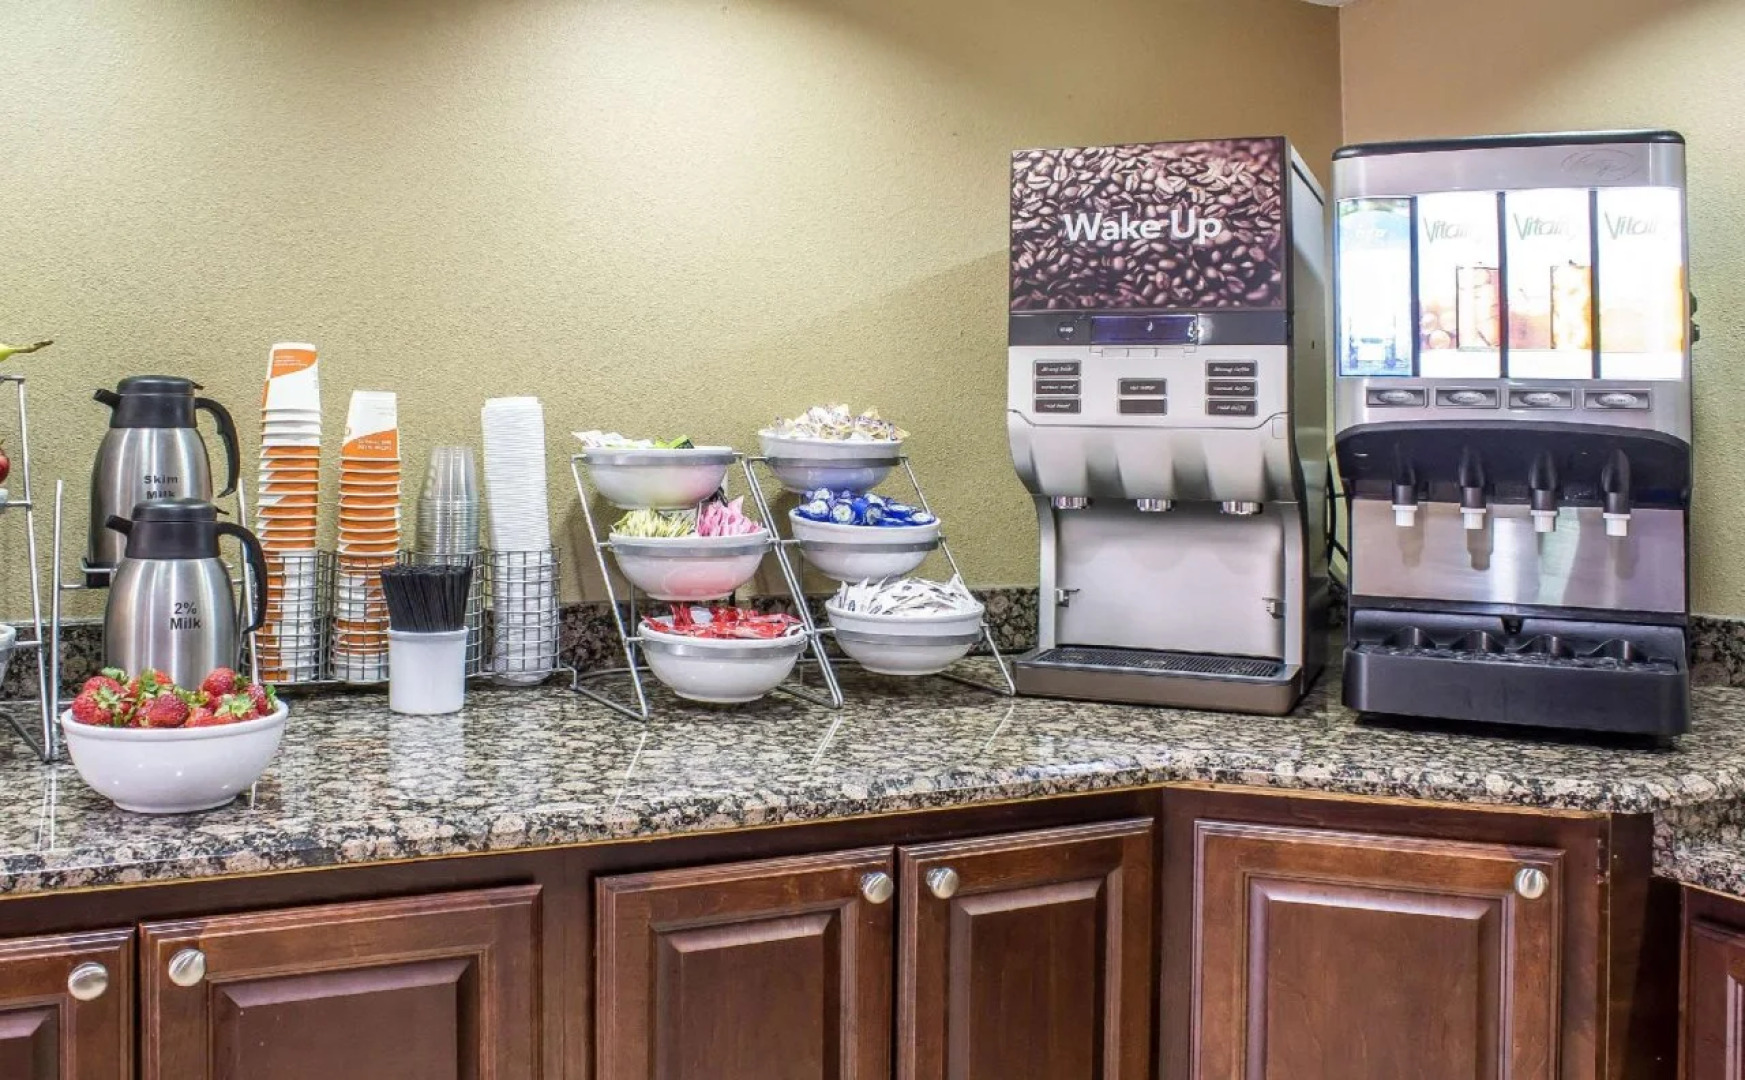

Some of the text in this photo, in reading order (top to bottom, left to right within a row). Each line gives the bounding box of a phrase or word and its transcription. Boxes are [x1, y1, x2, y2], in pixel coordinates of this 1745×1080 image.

[1063, 208, 1223, 246] Wake Up
[1422, 216, 1482, 244] Vitali
[1513, 211, 1576, 241] Vitali
[1604, 209, 1670, 241] Vitali
[143, 474, 179, 485] Skim
[146, 489, 176, 500] Milk
[174, 602, 198, 615] 2%
[169, 617, 202, 631] Milk
